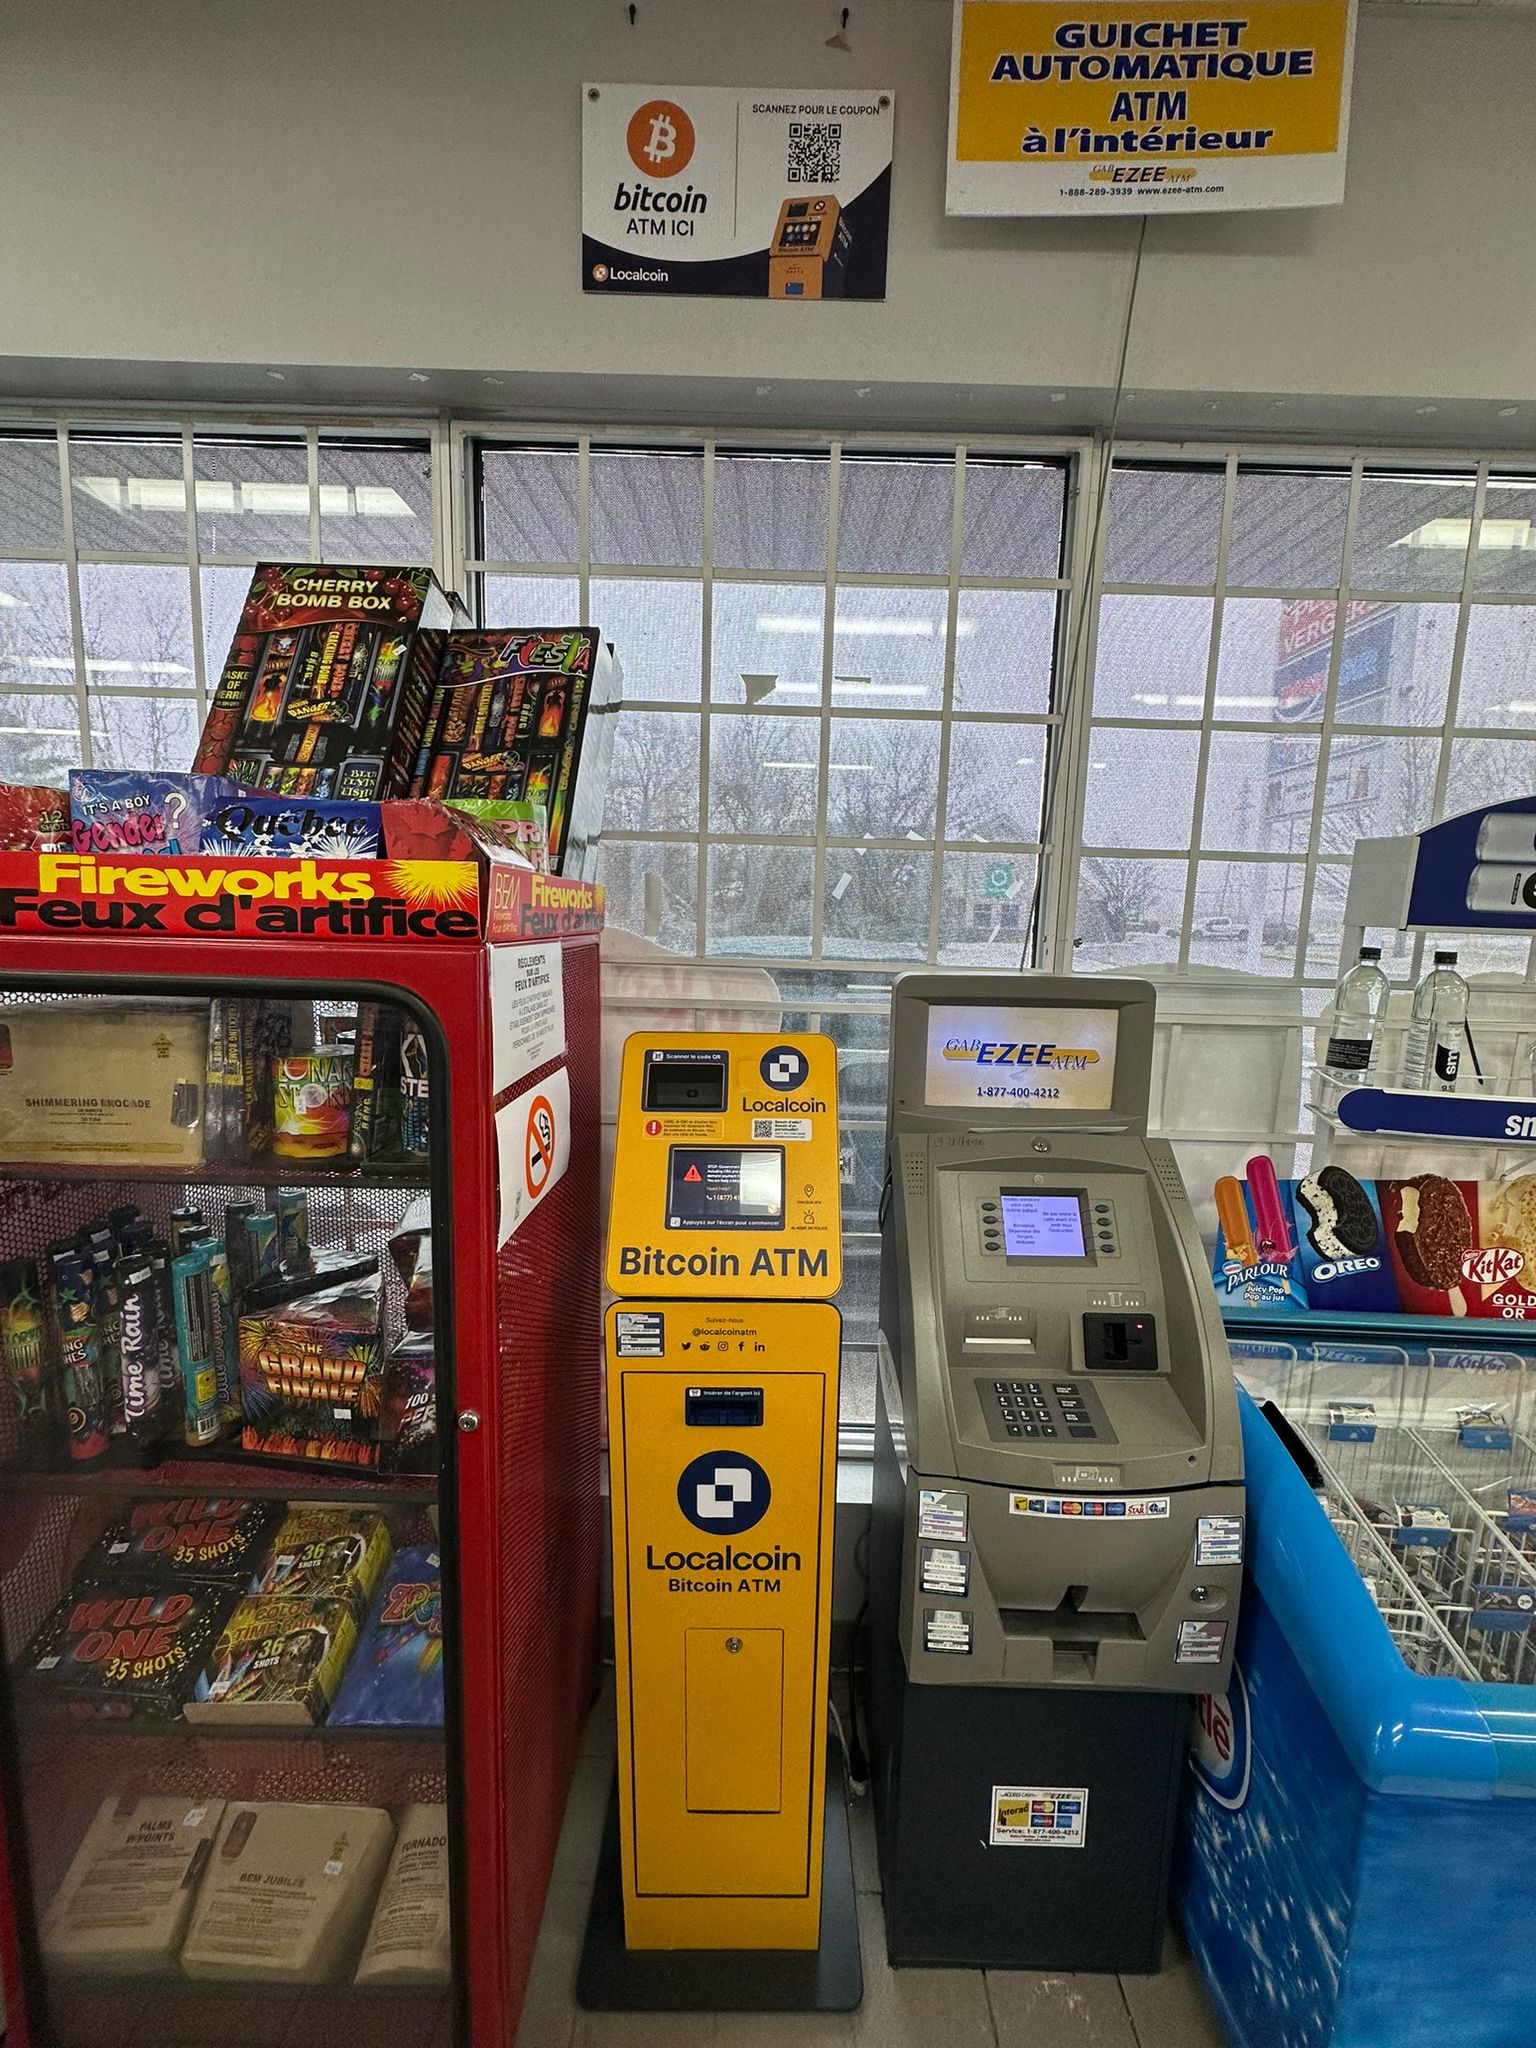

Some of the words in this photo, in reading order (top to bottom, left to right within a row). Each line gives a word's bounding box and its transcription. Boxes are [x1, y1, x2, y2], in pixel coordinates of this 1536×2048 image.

[1054, 21, 1248, 49] GUICHET
[990, 50, 1313, 82] AUTOMATIQUE
[752, 104, 797, 114] SCANNEZ
[799, 105, 824, 115] POUR
[826, 106, 837, 115] LE
[839, 106, 880, 115] COUPON
[1110, 91, 1187, 122] ATM
[1021, 127, 1048, 154] à
[1054, 126, 1274, 153] l'intérieur
[1112, 166, 1168, 183] EZEE
[613, 182, 707, 213] bitcoin
[1059, 187, 1132, 197] 1-888-289-3939
[1137, 184, 1224, 196] www.ezee-atm.com
[626, 219, 666, 235] ATM
[672, 220, 694, 236] ICI
[610, 267, 668, 282] Localcoin
[293, 578, 379, 593] CHERRY
[277, 593, 343, 608] BOMB
[347, 595, 392, 610] BOX
[227, 681, 241, 690] OF
[82, 802, 109, 816] IT'S
[112, 801, 121, 811] A
[125, 794, 150, 809] BOY
[40, 822, 70, 832] SHOTS
[72, 812, 166, 853] Gender
[39, 853, 375, 900] Fireworks
[531, 874, 593, 910] Fireworks
[0, 888, 168, 931] Feux
[184, 893, 479, 937] d'artifice
[520, 903, 557, 936] Feux
[561, 905, 606, 934] d'artifice
[515, 979, 528, 992] FEUX
[945, 1038, 980, 1051] GAB
[976, 1043, 1056, 1065] EZEE
[1051, 1054, 1088, 1070] ATM
[978, 1086, 1060, 1098] 1-877-400-4212
[25, 1098, 98, 1108] SHIMMERING
[742, 1097, 826, 1113] Localcoin
[683, 1219, 705, 1227] Appuyez
[620, 1246, 739, 1276] Bitcoin
[750, 1248, 828, 1277] ATM
[1313, 1257, 1381, 1281] OREO
[1468, 1249, 1521, 1282] KitKat
[1228, 1263, 1288, 1292] PARLOUR
[1247, 1285, 1267, 1294] Juicy
[1272, 1293, 1285, 1301] jus
[1492, 1293, 1536, 1307] GOLD
[1502, 1307, 1525, 1319] OR
[121, 1292, 142, 1355] Rain
[692, 1328, 757, 1337] @localcoinatm
[300, 1343, 324, 1354] THE
[258, 1350, 367, 1383] GRAND
[125, 1363, 145, 1423] Time
[266, 1376, 361, 1403] FINALE
[732, 1390, 752, 1398] l'argent
[142, 1518, 236, 1551] ONE
[173, 1546, 196, 1563] 35
[199, 1533, 246, 1562] SHOTS
[302, 1542, 328, 1561] 36
[646, 1544, 801, 1571] Localcoin
[298, 1560, 321, 1569] SHOTS
[669, 1578, 732, 1592] Bitcoin
[738, 1579, 781, 1592] ATM
[68, 1594, 193, 1632] WILD
[73, 1622, 182, 1662] ONE
[258, 1638, 286, 1658] 36
[105, 1658, 129, 1681] 35
[132, 1646, 187, 1679] SHOTS
[253, 1656, 280, 1669] SHOTS
[999, 1804, 1029, 1817] Interac
[402, 1836, 447, 1852] TORNADO
